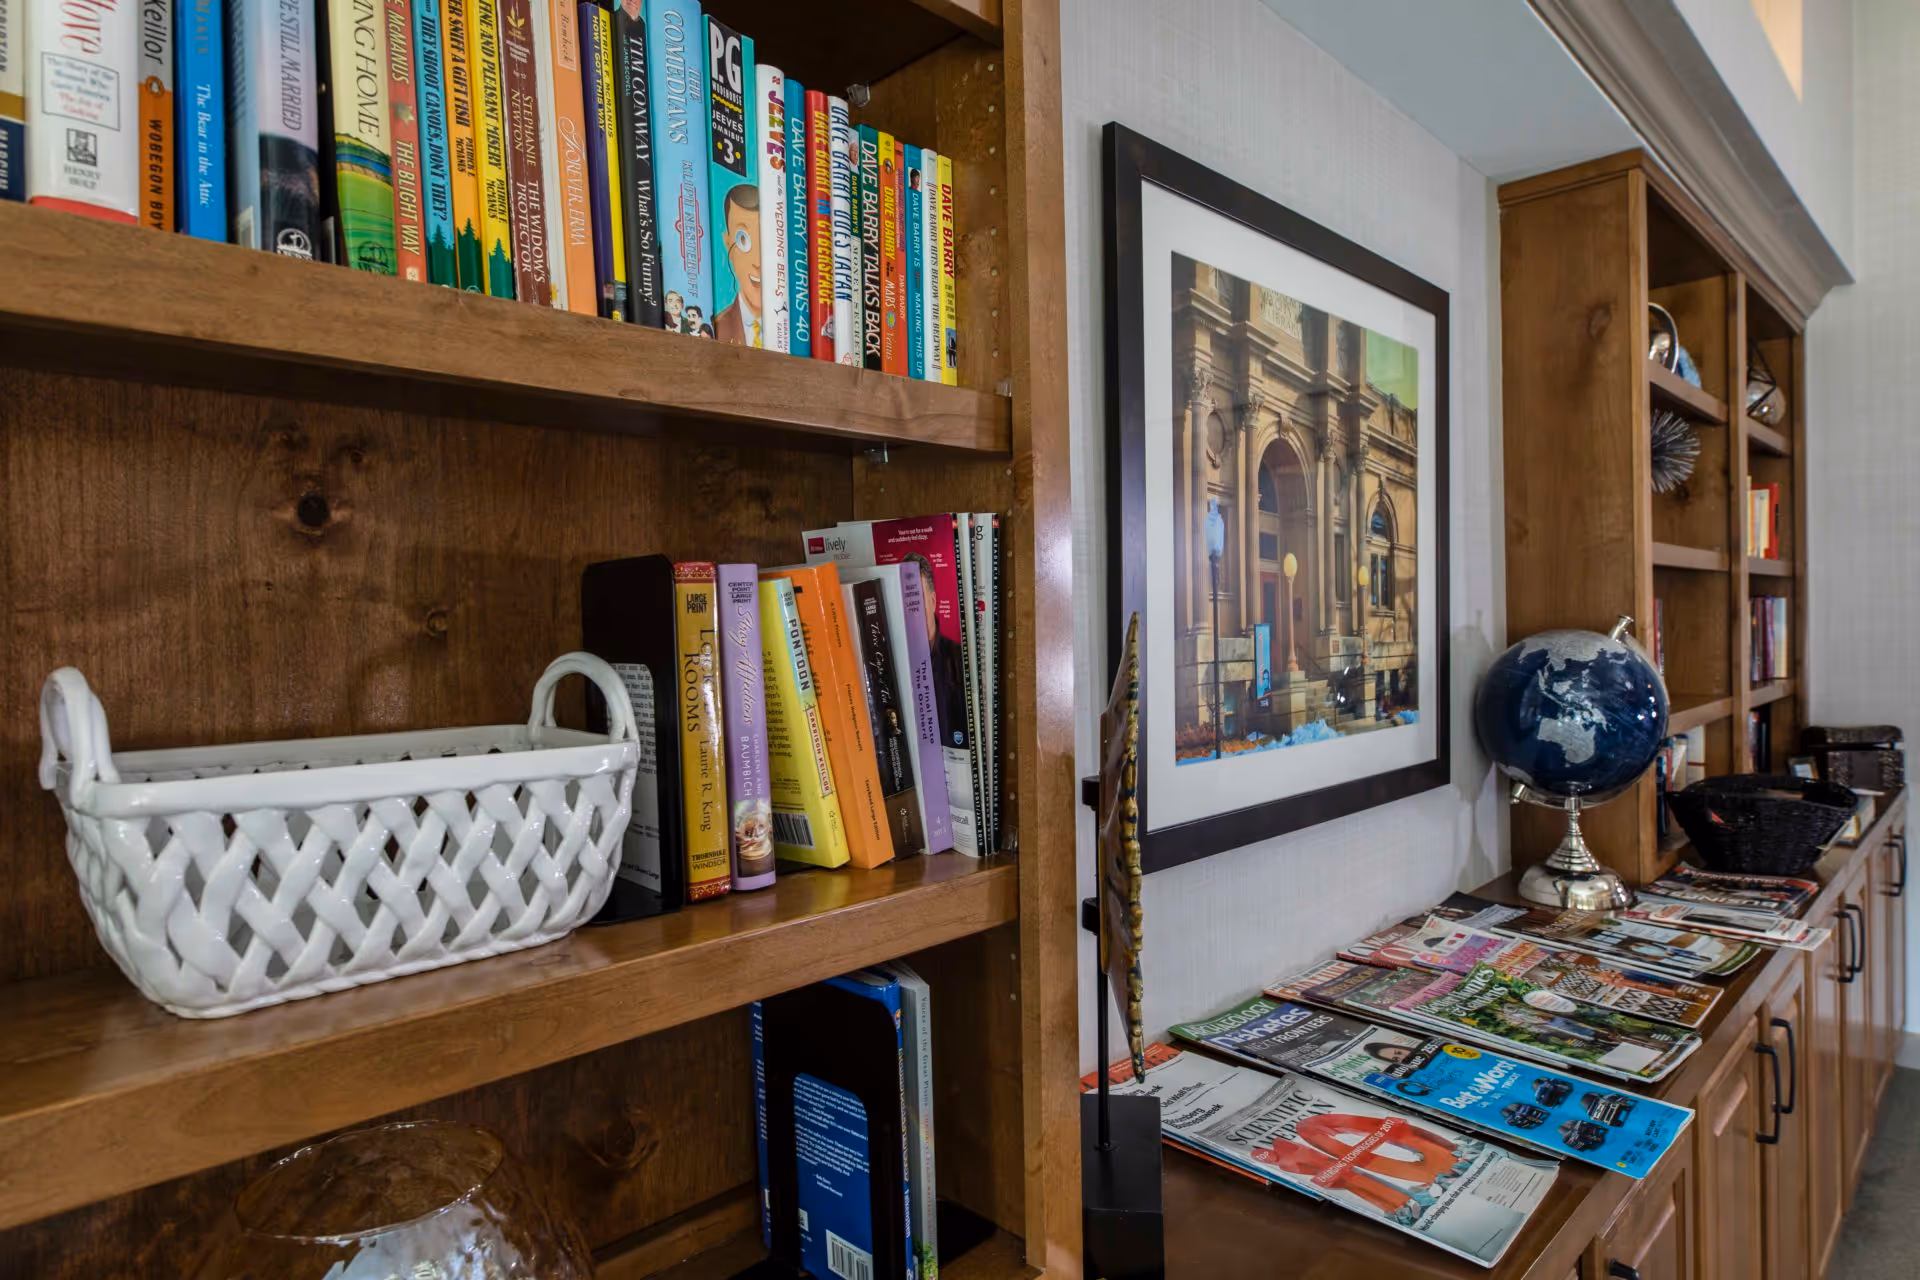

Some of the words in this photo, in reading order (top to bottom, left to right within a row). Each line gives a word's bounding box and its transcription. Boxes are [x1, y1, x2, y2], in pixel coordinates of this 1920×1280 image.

[421, 15, 437, 49] THEY
[478, 0, 494, 30] FINE
[592, 15, 600, 41] HOW
[387, 9, 409, 85] McMANUS
[448, 16, 466, 56] SNIFF
[480, 29, 496, 59] AND
[600, 18, 610, 69] PATRICK
[422, 46, 440, 93] SHOOT
[451, 53, 466, 64] A
[629, 36, 645, 75] TIM
[280, 53, 303, 131] MARRIED
[355, 50, 380, 138] HOME
[451, 65, 469, 98] GIFT
[481, 58, 499, 126] PLEASANT
[595, 76, 603, 106] THIS
[663, 8, 689, 146] COMEDIANS
[711, 81, 743, 107] WODEHOUSE
[197, 84, 211, 108] The
[454, 97, 471, 129] FISH
[198, 110, 212, 138] Bear
[511, 88, 523, 152] NEWTON
[522, 93, 536, 168] STEPHANIE
[597, 107, 606, 132] WAY
[632, 76, 650, 166] CONWAY
[712, 109, 744, 134] JEEVES
[712, 121, 744, 145] OMNIBUS
[767, 89, 787, 174] JEEVES
[813, 110, 830, 146] DAVE
[831, 105, 850, 147] DAVE
[149, 119, 163, 195] WOBEGON
[198, 143, 214, 155] in
[395, 140, 414, 168] THE
[486, 121, 502, 170] MISERY
[722, 138, 735, 165] 3
[791, 116, 806, 168] DAVE
[199, 157, 213, 176] the
[814, 148, 832, 198] BARRY
[832, 149, 850, 203] BARRY
[861, 139, 879, 188] DAVE
[199, 178, 214, 208] Attic
[397, 168, 418, 222] BLIGHT
[431, 181, 448, 222] THEY?
[526, 179, 541, 212] THE
[636, 179, 652, 229] What's
[851, 175, 859, 197] DAVE
[884, 185, 895, 218] DAVE
[928, 185, 937, 214] DAVE
[941, 183, 953, 223] DAVE
[150, 200, 163, 230] BOY
[793, 173, 808, 243] BARRY
[816, 198, 832, 216] IN
[852, 197, 860, 236] BARRY'S
[862, 189, 880, 254] BARRY
[911, 191, 920, 220] DAVE
[401, 222, 420, 257] WAY
[516, 181, 532, 273] PROTECTOR
[568, 206, 587, 247] ERMA
[640, 228, 653, 251] So
[775, 201, 785, 259] WEDDING
[833, 209, 852, 249] DOES
[884, 218, 897, 262] BARRY
[912, 221, 921, 255] BARRY
[929, 213, 938, 244] BARRY
[530, 213, 547, 284] WIDOW'S
[684, 210, 699, 299] NESTEROFF
[815, 219, 835, 306] CYBERSPACE
[913, 260, 921, 268] IS
[930, 243, 938, 268] HITS
[942, 223, 955, 279] BARRY
[638, 251, 658, 307] Funny?
[774, 262, 785, 298] BELLS
[794, 246, 809, 316] TURNS
[834, 253, 853, 304] JAPAN
[863, 252, 881, 310] TALKS
[884, 278, 896, 310] MARS
[931, 267, 939, 300] BELOW
[914, 291, 923, 333] MAKING
[932, 300, 940, 320] THE
[795, 315, 811, 343] 40
[864, 310, 882, 358] BACK
[915, 334, 923, 359] THIS
[932, 321, 941, 363] BELTWAY
[916, 360, 924, 375] UP
[824, 537, 847, 553] lively
[686, 593, 708, 603] LARGE
[687, 602, 708, 614] PRINT
[788, 618, 811, 692] PONTOON
[684, 652, 702, 733] ROOMS
[924, 685, 933, 713] Final
[917, 692, 927, 741] Orchard
[927, 716, 935, 745] Note
[699, 739, 711, 779] Laurie
[739, 735, 753, 797] BAUMBICH
[808, 710, 823, 754] GARRISON
[818, 756, 831, 792] KEILLOR
[969, 735, 977, 765] TRAVEL
[701, 783, 713, 798] R.
[700, 800, 713, 833] King
[692, 858, 727, 871] WINDSOR
[1180, 1000, 1276, 1039] ARCHAEOLOGY
[1276, 1013, 1335, 1044] FRONTIERS
[1318, 1053, 1373, 1077] Arthritis
[1420, 1040, 1441, 1055] 255
[1438, 1090, 1483, 1110] Best
[1473, 1058, 1518, 1095] Worst
[1170, 1102, 1225, 1131] Businessweek
[1225, 1088, 1315, 1148] SCIENTIFIC
[1255, 1150, 1271, 1162] TOP
[1319, 1158, 1348, 1183] EMERGING
[1342, 1132, 1379, 1164] TECHNOLOGIES
[1379, 1118, 1395, 1134] 2017
